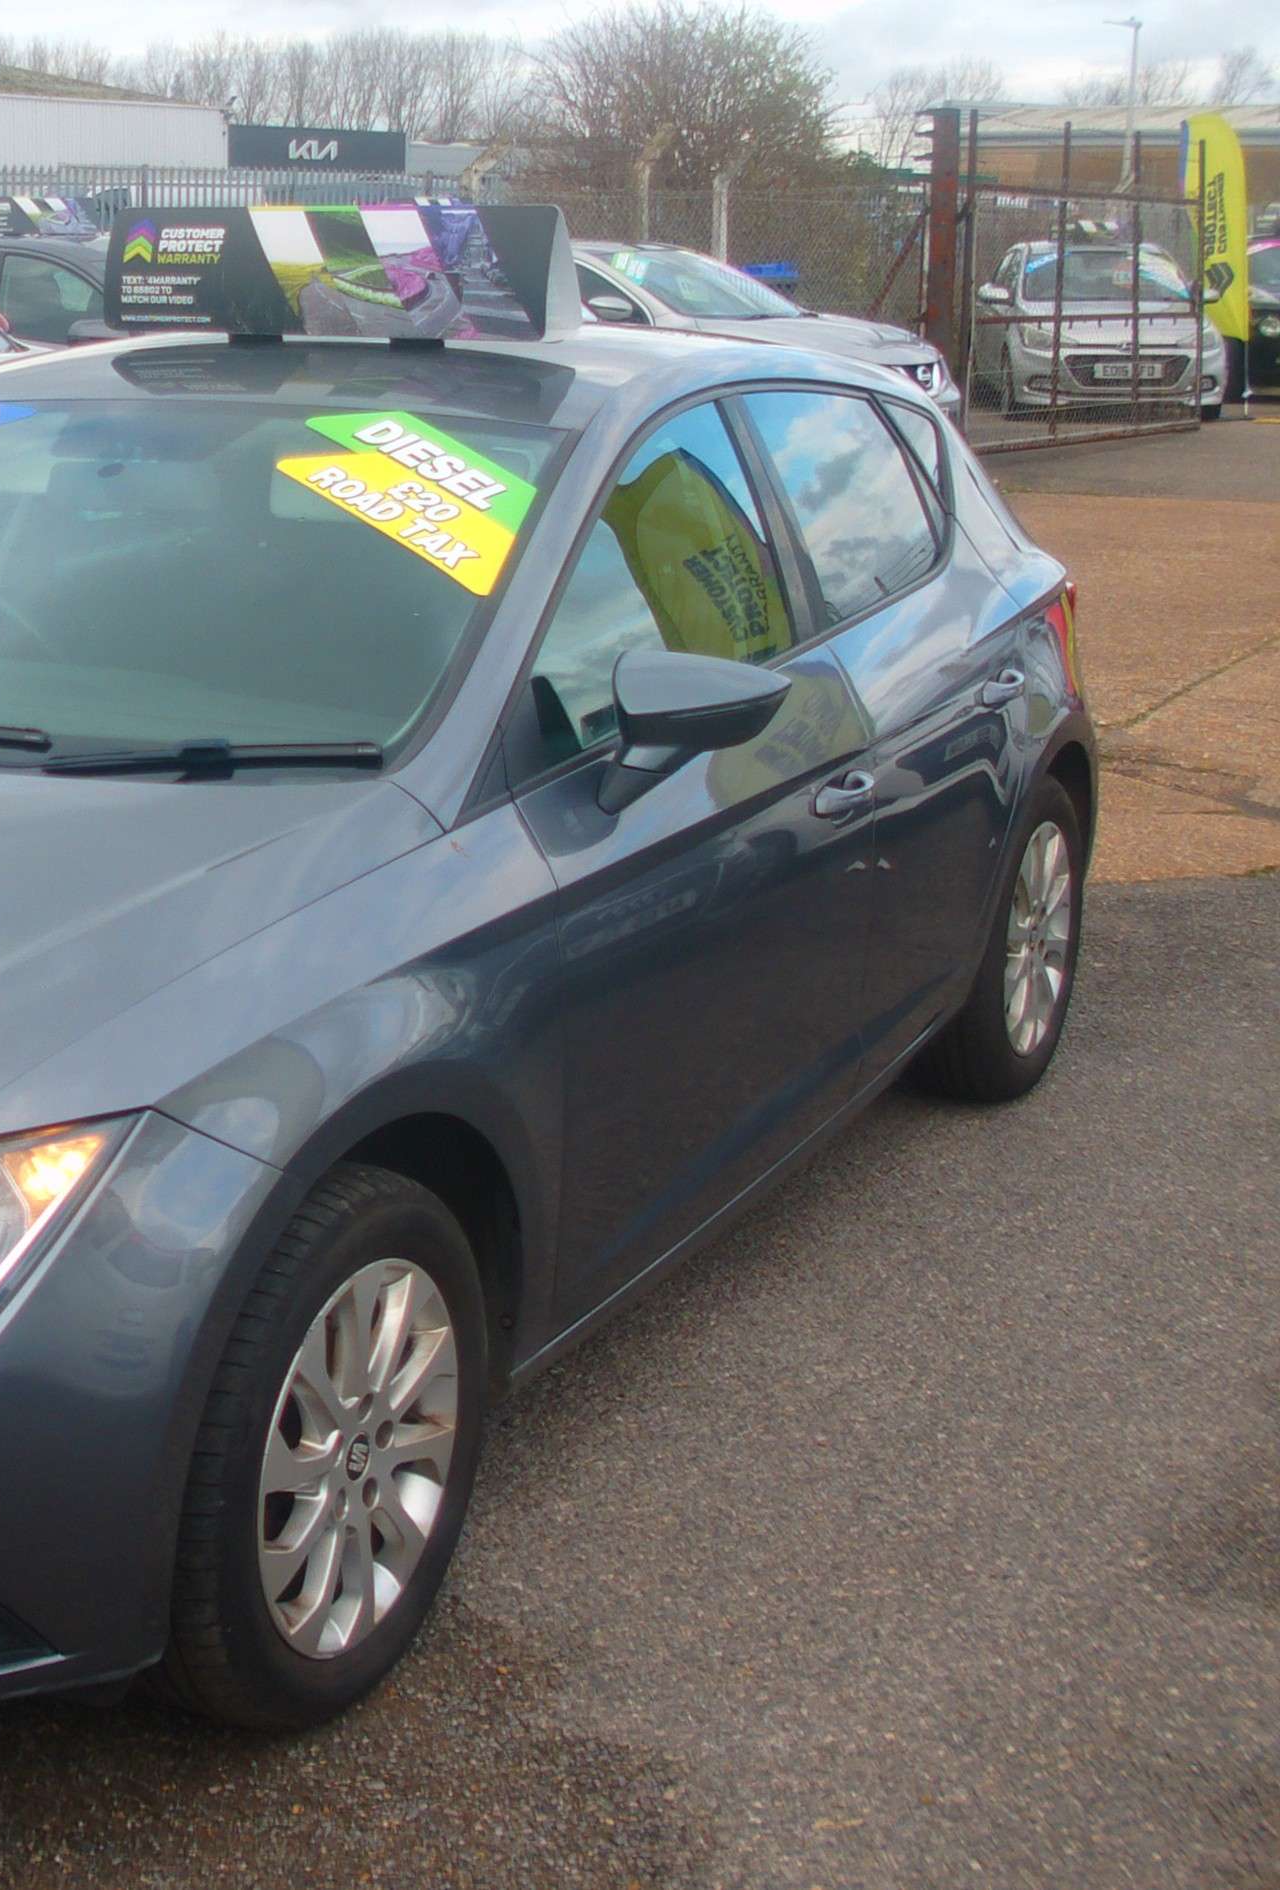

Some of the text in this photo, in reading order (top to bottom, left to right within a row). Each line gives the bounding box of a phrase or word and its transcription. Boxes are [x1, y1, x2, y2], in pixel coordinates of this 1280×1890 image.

[288, 139, 338, 160] KIA
[161, 228, 225, 239] CUSTOMER
[158, 240, 223, 252] PROTECT
[157, 253, 220, 264] WARRANTY
[161, 286, 172, 294] TO
[121, 296, 193, 304] WATCH OUR VIDEO
[353, 419, 507, 511] DIESEL
[386, 481, 461, 523] £20
[306, 466, 480, 569] ROAD TAX
